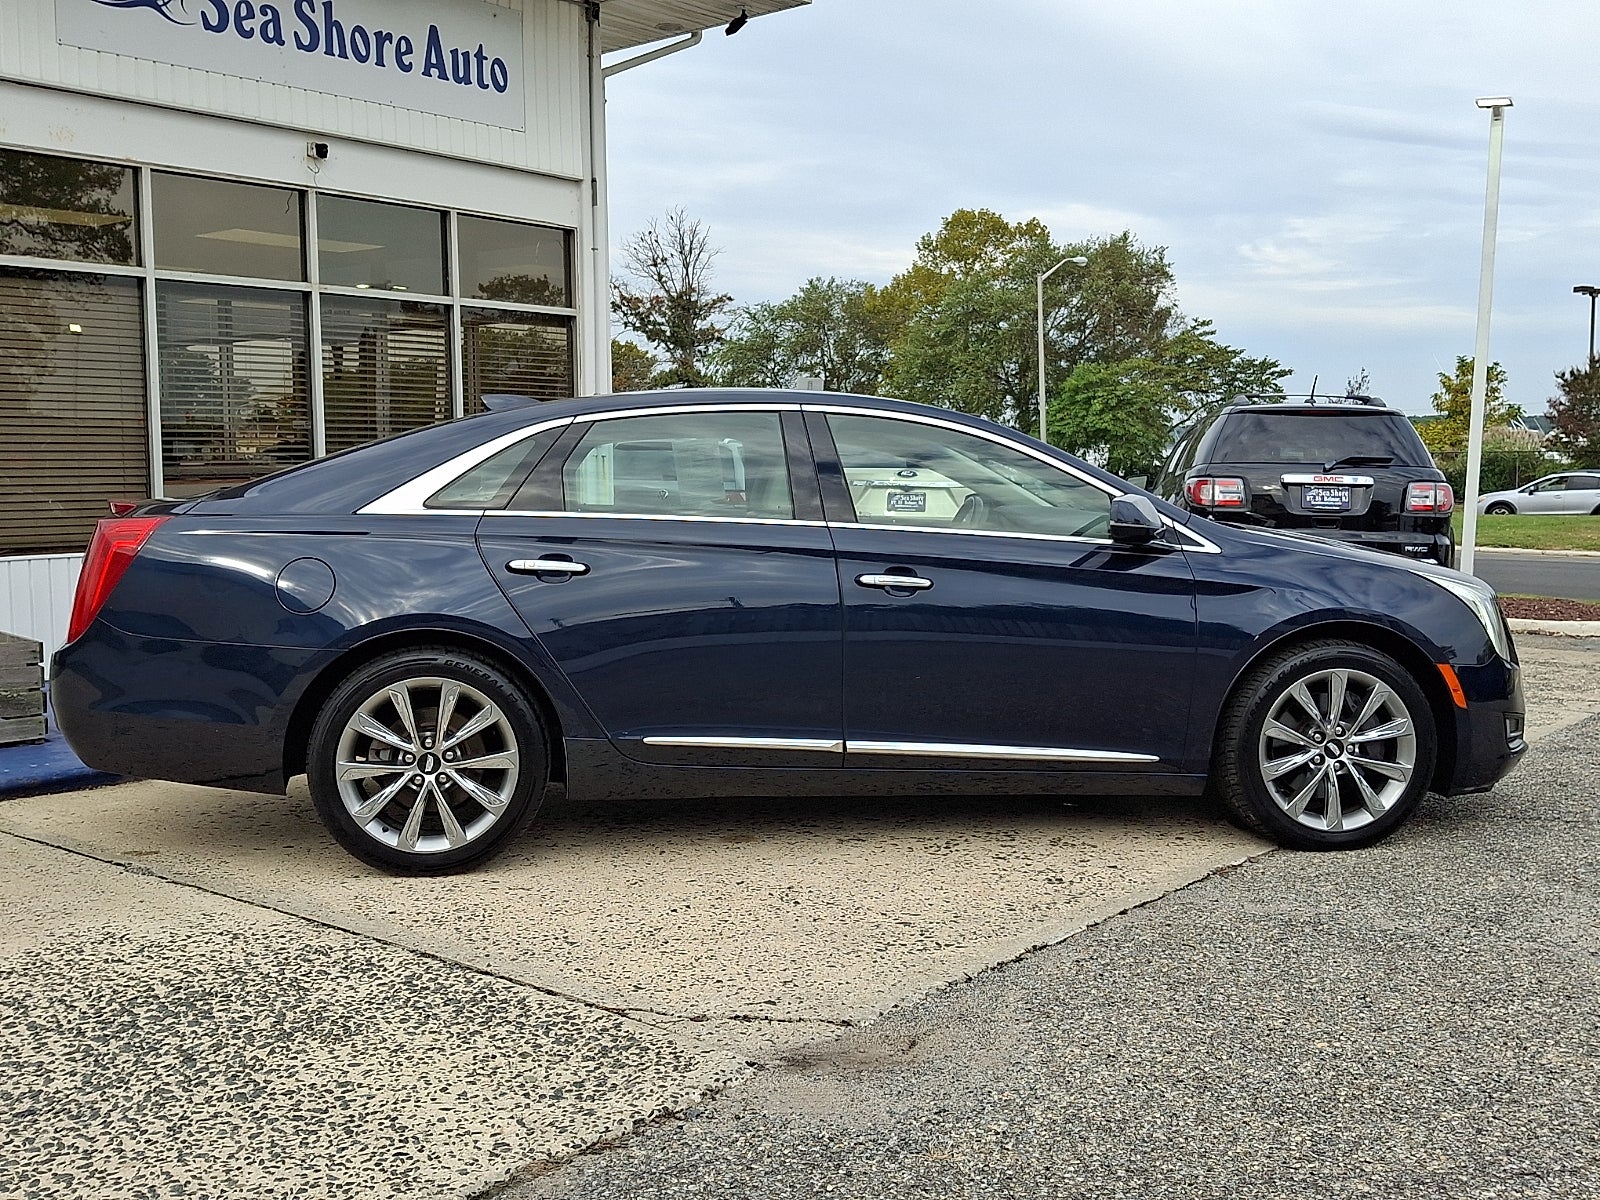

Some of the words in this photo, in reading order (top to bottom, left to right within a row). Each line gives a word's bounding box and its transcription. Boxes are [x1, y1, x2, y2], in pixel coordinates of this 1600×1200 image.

[200, 0, 286, 46] Sea
[293, 0, 414, 73] Shore
[421, 24, 508, 93] Auto
[443, 659, 505, 690] GENERAL
